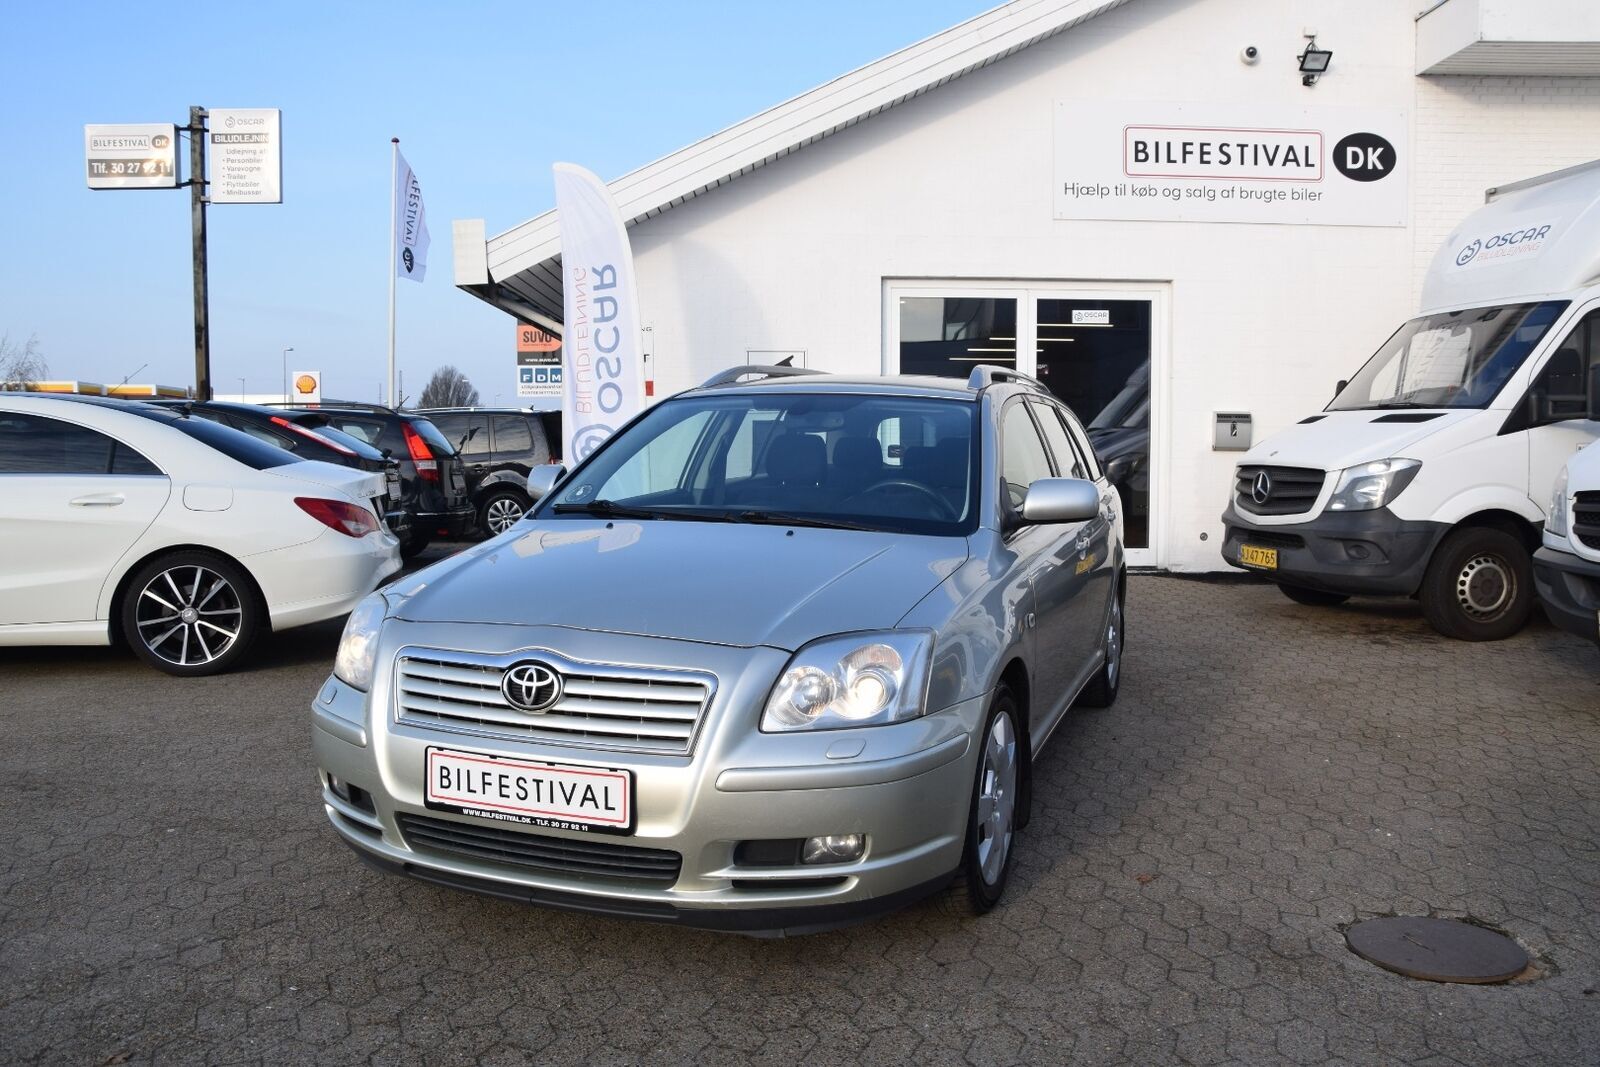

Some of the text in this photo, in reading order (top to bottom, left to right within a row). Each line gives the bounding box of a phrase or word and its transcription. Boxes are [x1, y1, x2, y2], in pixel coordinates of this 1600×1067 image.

[237, 118, 264, 126] OSCAR
[93, 139, 148, 147] BILFESTIVAL
[155, 139, 168, 147] DK
[1134, 140, 1315, 168] BILFESTIVAL
[92, 162, 108, 174] Tlf.
[111, 163, 125, 173] 30
[127, 163, 141, 173] 27
[1346, 146, 1384, 170] DK
[1064, 182, 1322, 203] Hjælp til køb og salg af brugte biler
[406, 175, 420, 241] LFESTIVAL
[1485, 224, 1551, 250] OSCAR
[523, 374, 561, 383] FDM
[439, 765, 616, 811] BILFESTIVAL
[462, 808, 531, 825] WWW.BILFESTIVAL.DK
[536, 819, 550, 827] TLF.
[571, 823, 580, 831] 92
